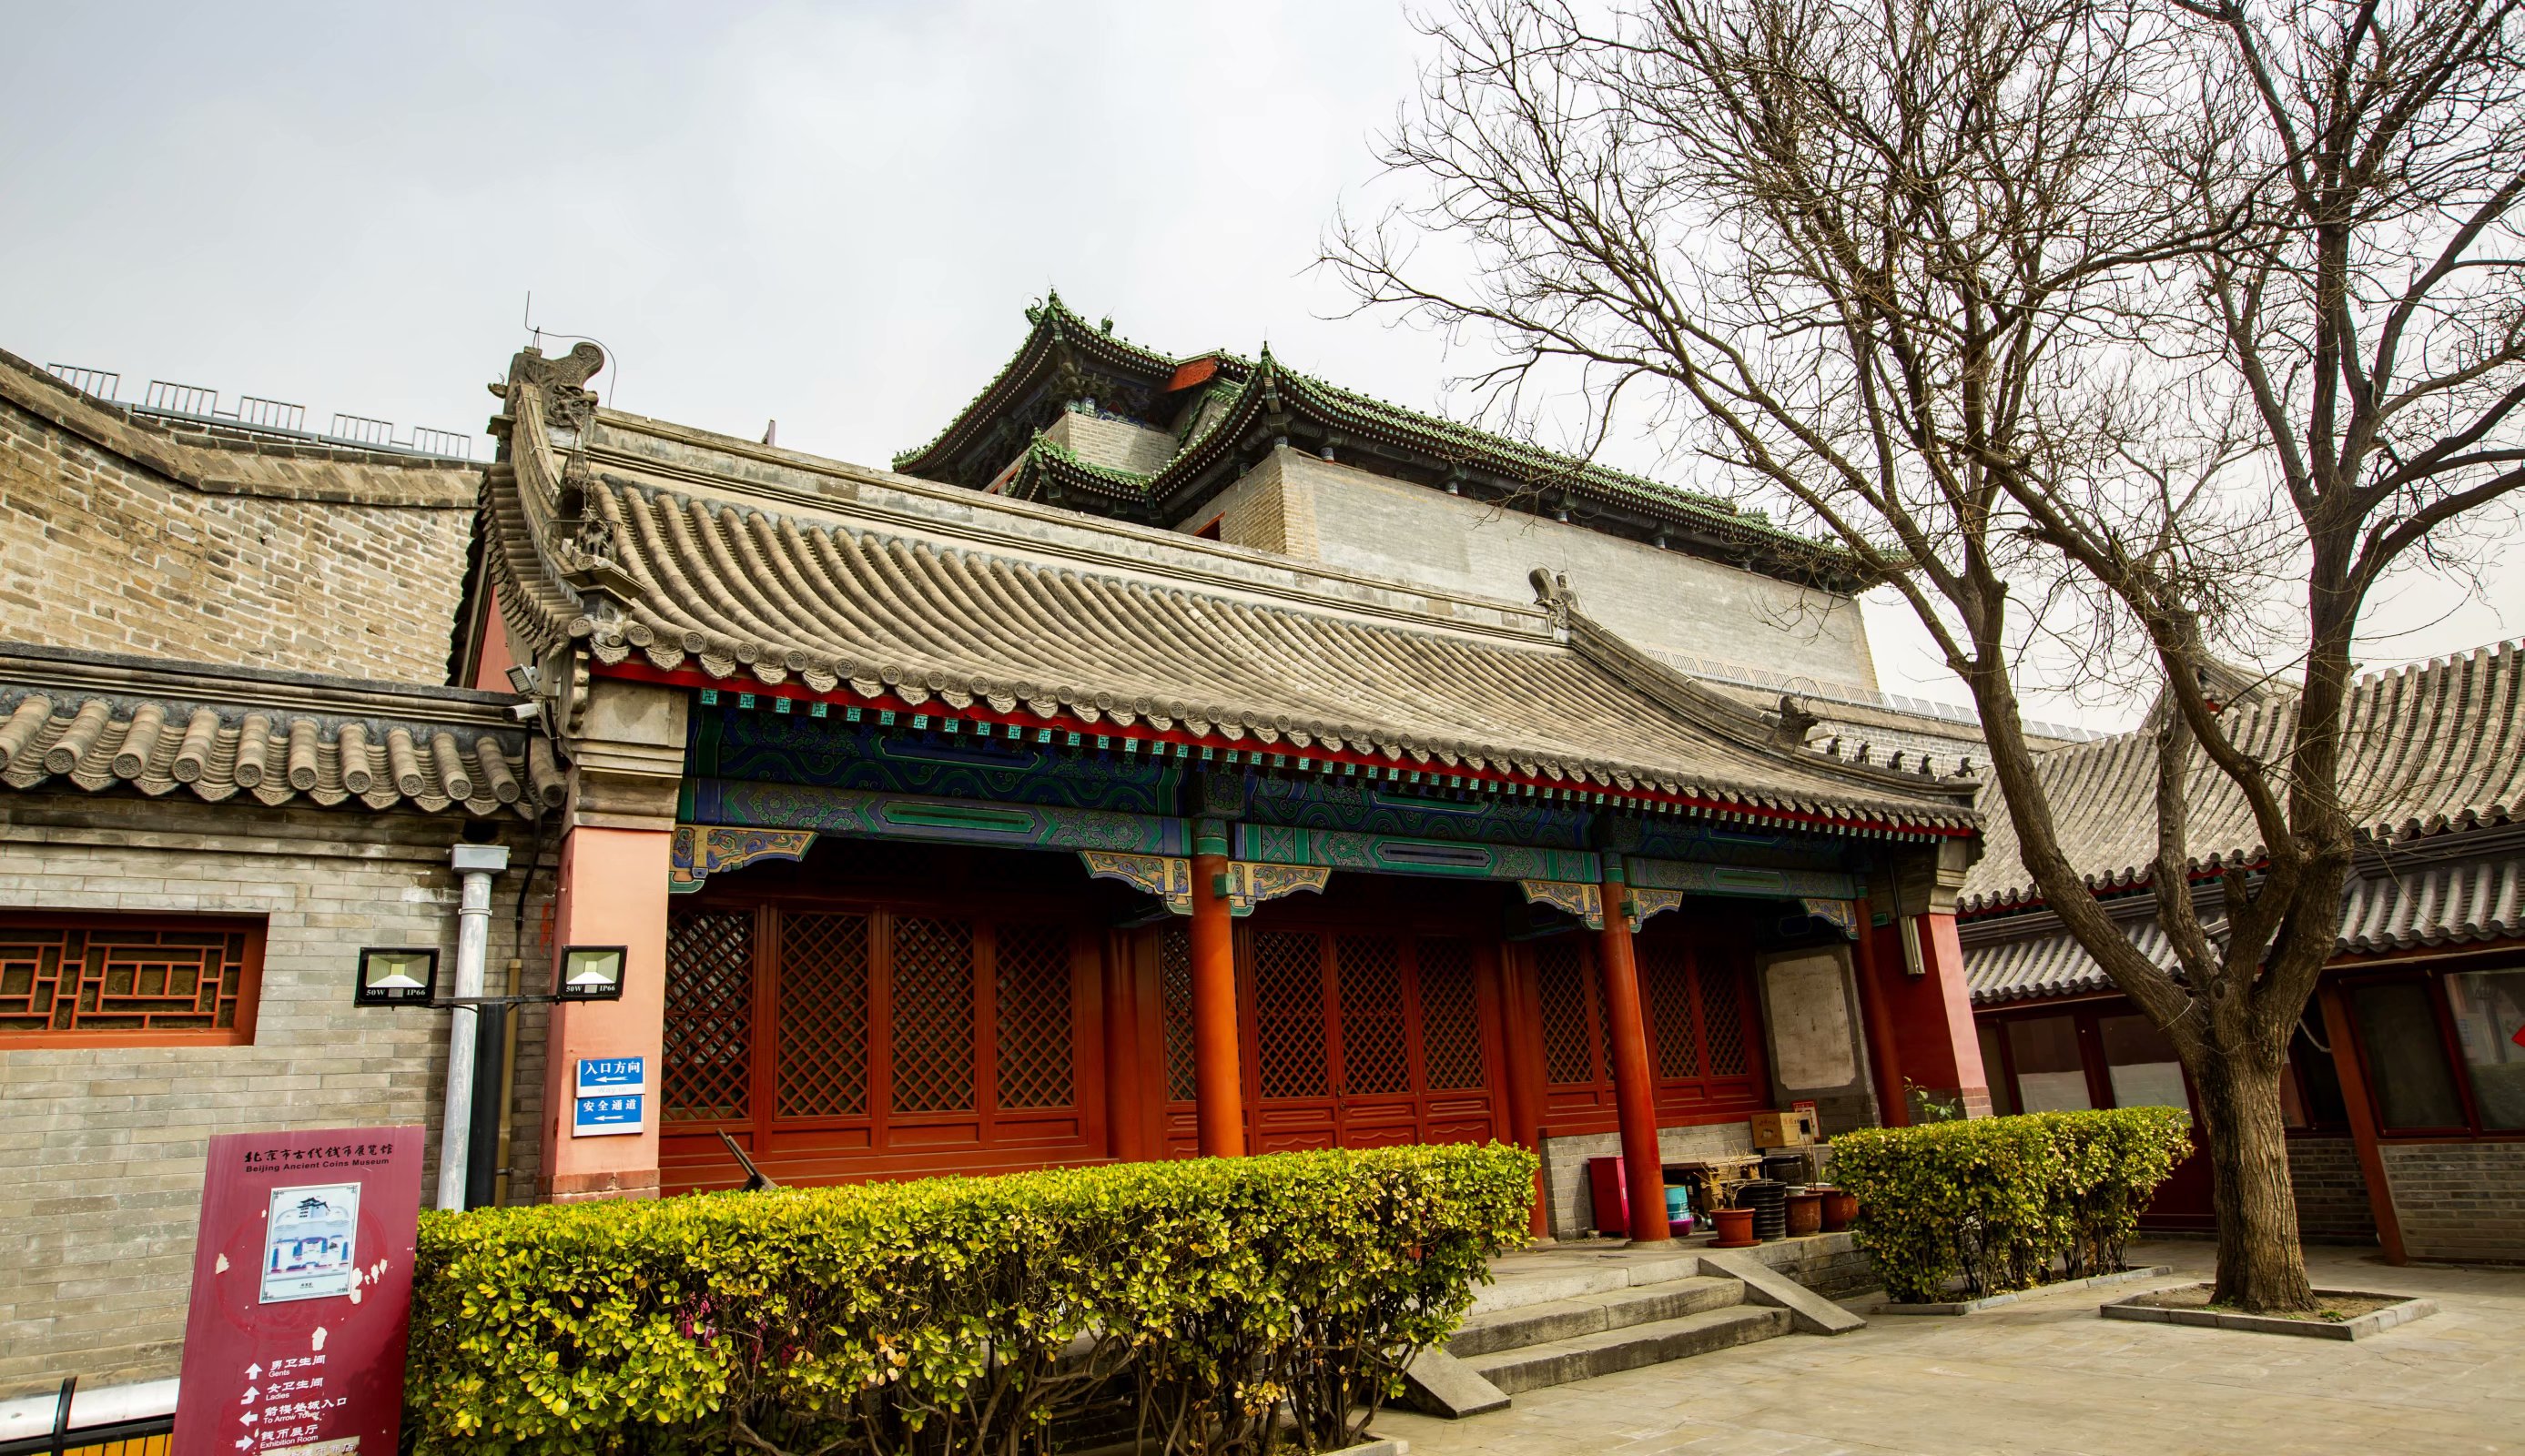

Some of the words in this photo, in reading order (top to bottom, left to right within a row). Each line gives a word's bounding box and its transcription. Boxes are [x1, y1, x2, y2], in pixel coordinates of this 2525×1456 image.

[584, 1060, 640, 1076] 入口方向
[583, 1099, 636, 1112] 安全通道
[246, 1164, 279, 1173] Beijing
[282, 1161, 319, 1170] Ancient
[322, 1160, 350, 1168] Coins
[351, 1158, 390, 1167] Museum
[271, 1355, 326, 1370] 男卫生间
[268, 1378, 323, 1393] 女卫生间
[261, 1424, 318, 1441] 钱币展厅
[260, 1440, 295, 1449] Exhibition
